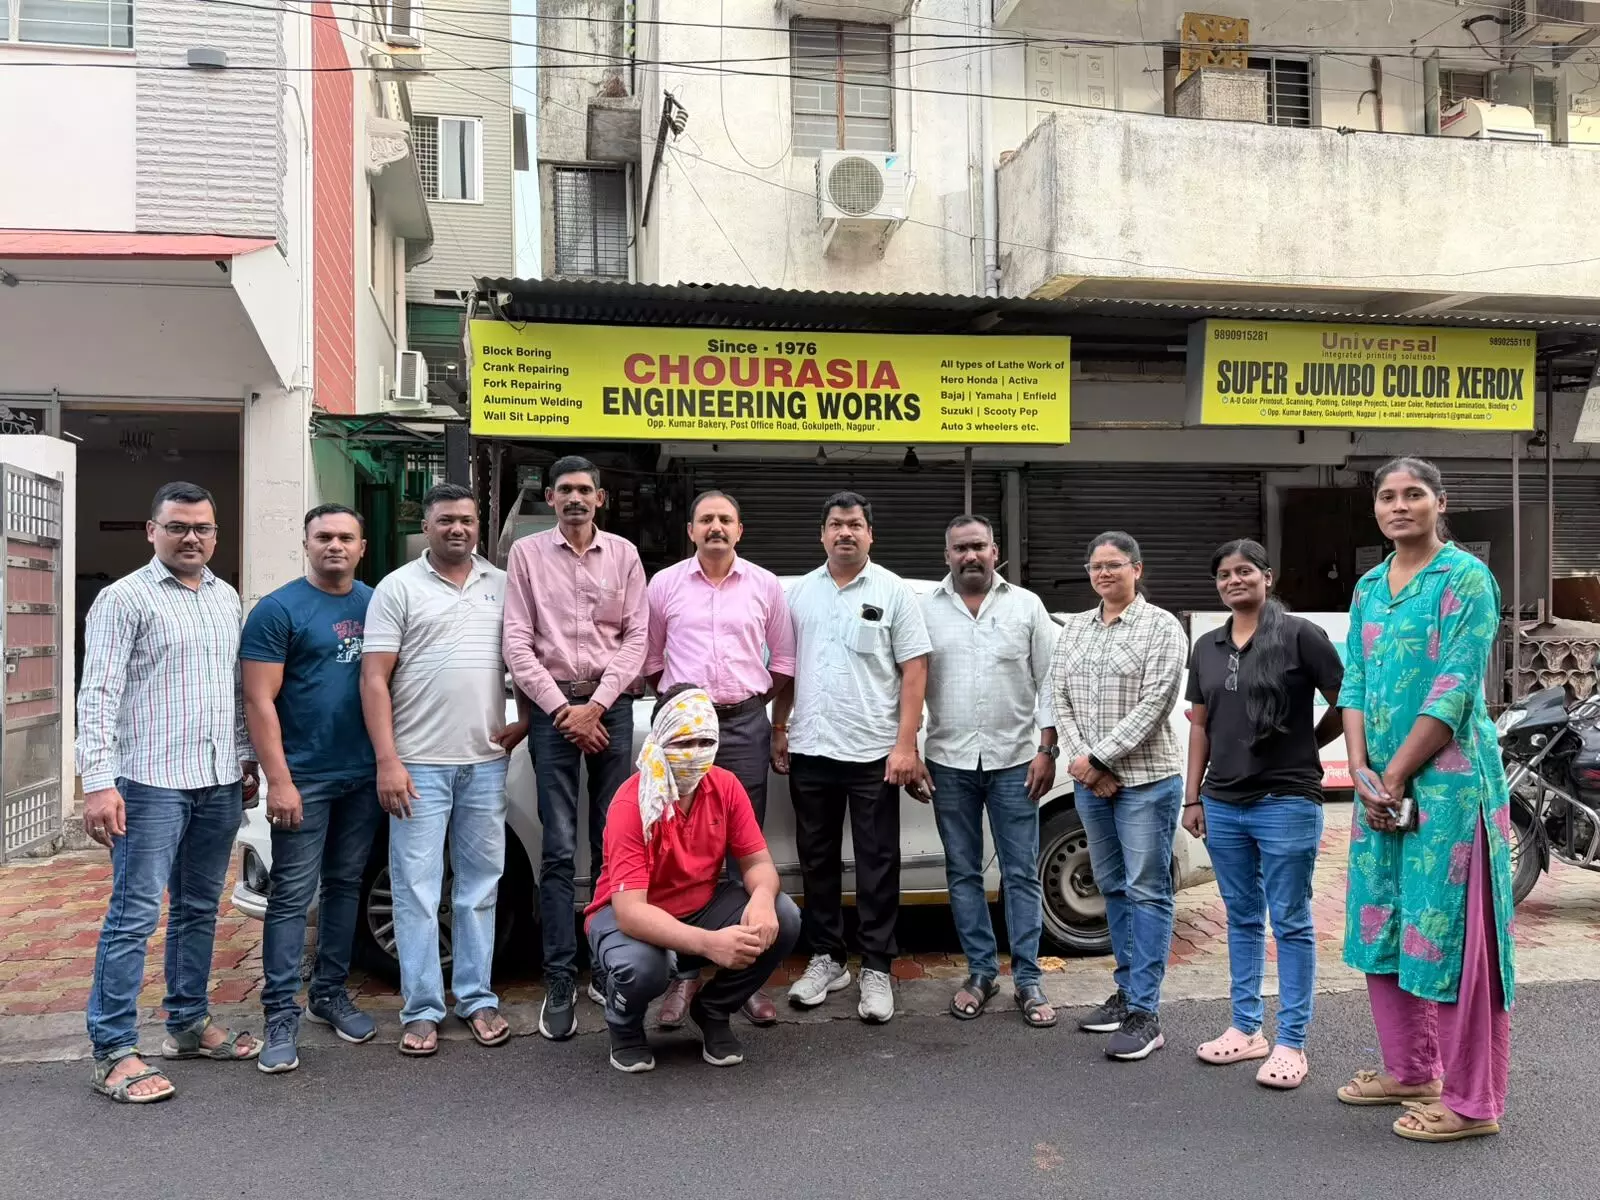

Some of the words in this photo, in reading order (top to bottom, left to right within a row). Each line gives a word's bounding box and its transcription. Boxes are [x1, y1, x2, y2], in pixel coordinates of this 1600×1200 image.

[1214, 329, 1268, 341] 9890915281
[707, 339, 757, 353] Since
[775, 342, 817, 355] 1976
[1322, 333, 1437, 352] Universal
[483, 346, 513, 356] Block
[516, 347, 552, 359] Boring
[1322, 352, 1362, 360] integrated
[1366, 353, 1397, 361] printing
[483, 362, 515, 373] Crank
[518, 364, 569, 376] Repairing
[623, 353, 900, 389] CHOURASIA
[941, 360, 953, 369] All
[956, 361, 983, 371] types
[985, 360, 995, 369] of
[998, 360, 1025, 369] Lathe
[1027, 360, 1052, 369] Work
[1055, 361, 1065, 370] of
[483, 379, 508, 389] Fork
[511, 379, 561, 392] Repairing
[941, 376, 964, 385] Hero
[967, 376, 998, 385] Honda
[1008, 376, 1038, 385] Activa
[1217, 360, 1287, 395] SUPER
[1295, 363, 1375, 398] JUMBO
[1383, 365, 1450, 398] COLOR
[1456, 366, 1524, 400] XEROX
[483, 395, 537, 406] Aluminum
[540, 397, 583, 409] Welding
[941, 391, 965, 402] Bajaj
[975, 392, 1013, 400] Yamaha
[1023, 392, 1056, 401] Enfield
[602, 387, 807, 419] ENGINEERING
[817, 392, 921, 421] WORKS
[1242, 397, 1257, 405] Color
[1341, 399, 1363, 408] College
[1390, 400, 1406, 409] Laser
[1425, 401, 1453, 410] Reduction
[1488, 402, 1509, 411] Binding
[484, 411, 507, 420] Wall
[509, 412, 524, 421] Sit
[527, 412, 569, 424] Lapping
[941, 407, 974, 416] Suzuki
[984, 407, 1017, 417] Scooty
[1019, 407, 1038, 417] Pep
[1267, 409, 1280, 417] Opp.
[1282, 409, 1301, 417] Kumar
[1302, 409, 1324, 418] Bakery,
[647, 418, 666, 429] Opp.
[669, 419, 696, 428] Kumar
[698, 419, 728, 430] Bakery,
[730, 420, 748, 429] Post
[750, 420, 774, 430] Office
[777, 421, 800, 432] Road,
[941, 422, 963, 431] Auto
[966, 423, 972, 431] 3
[975, 423, 1019, 431] wheelers
[1021, 423, 1039, 431] etc.
